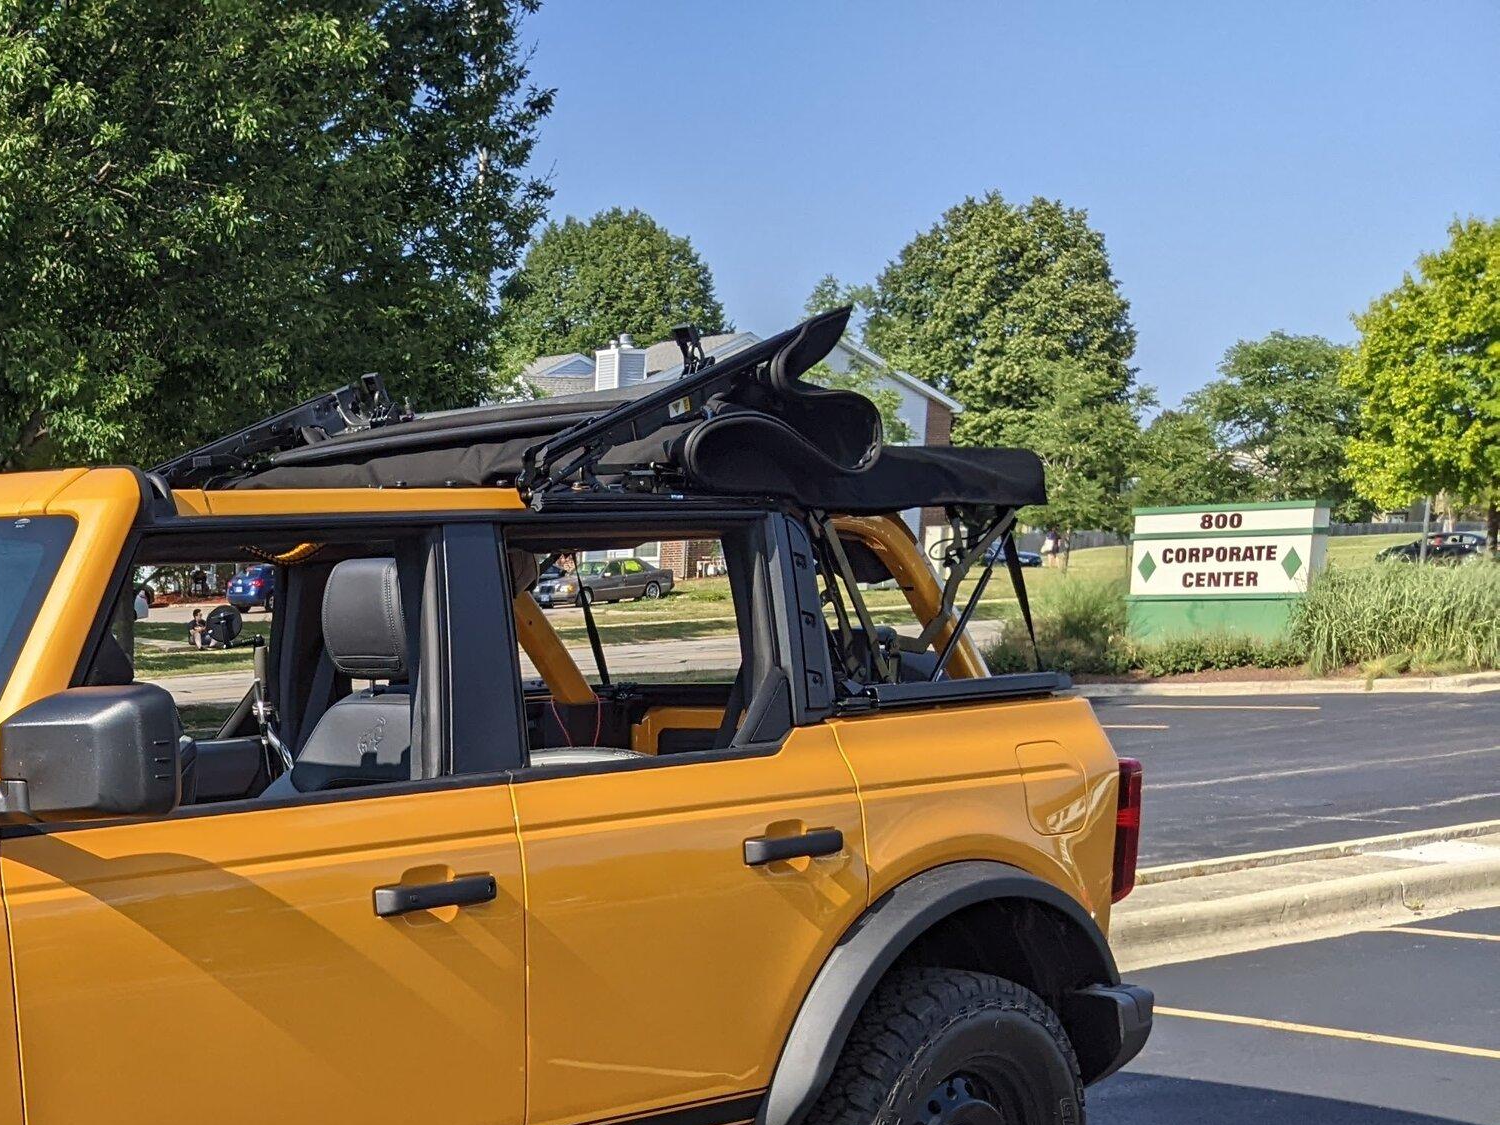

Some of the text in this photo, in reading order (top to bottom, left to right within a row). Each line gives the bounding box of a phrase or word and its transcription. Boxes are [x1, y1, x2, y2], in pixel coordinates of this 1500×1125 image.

[1199, 512, 1243, 530] 800
[1161, 545, 1278, 565] CORPORATE
[1181, 571, 1259, 588] CENTER
